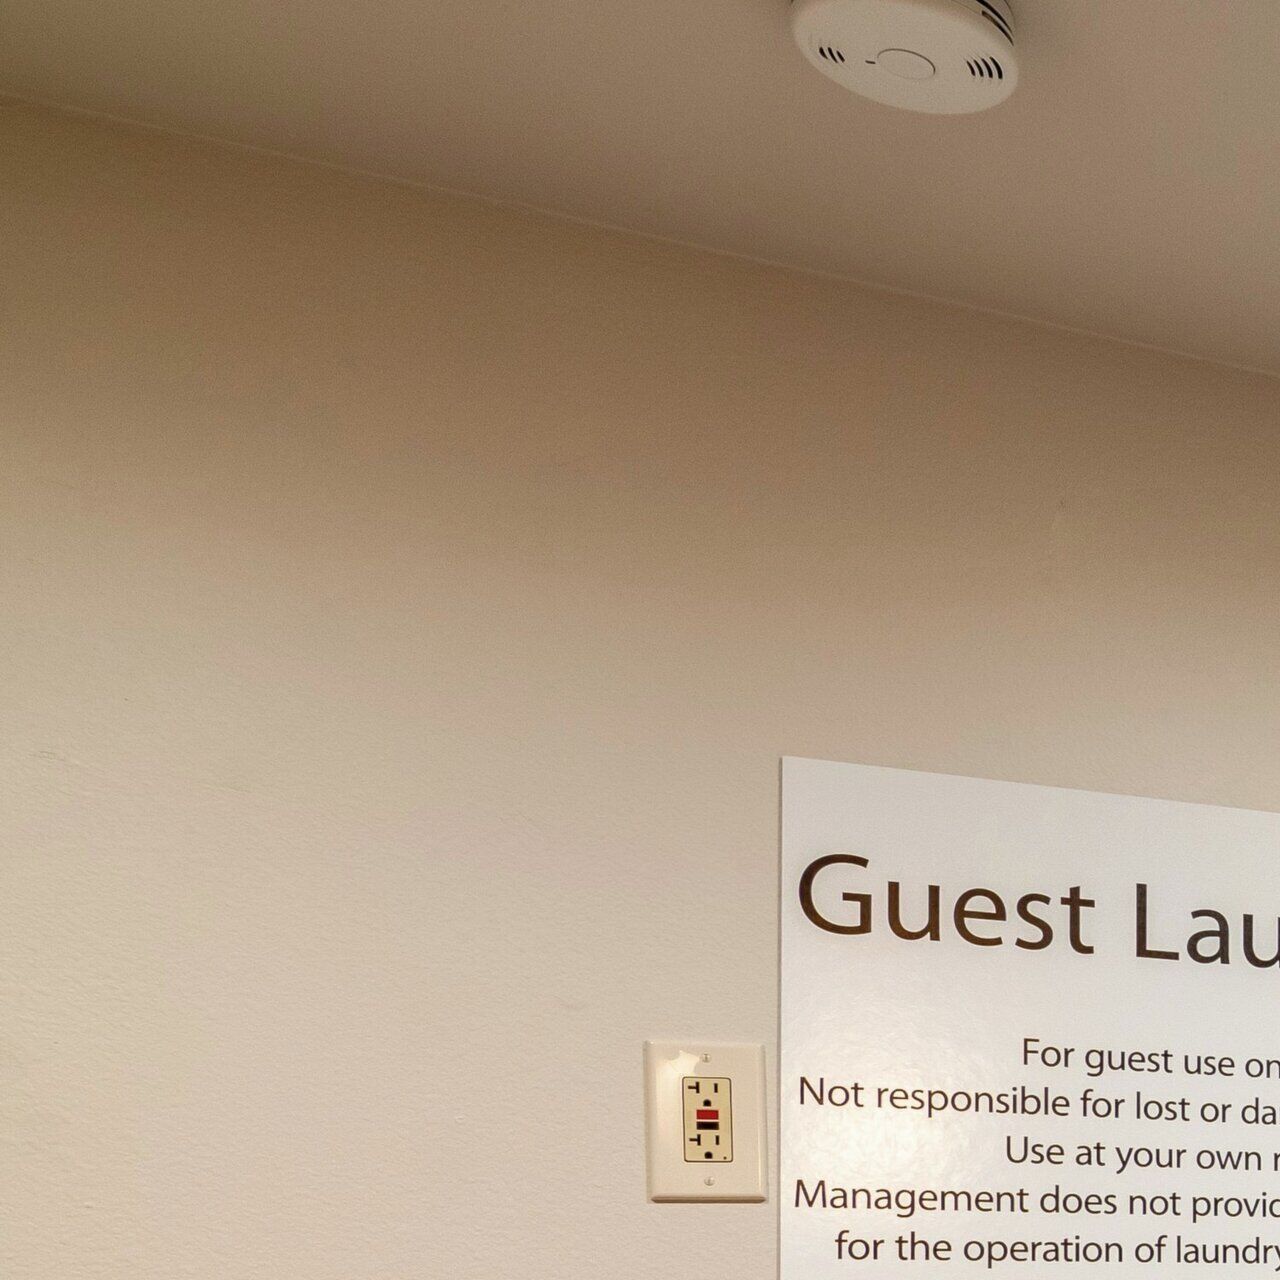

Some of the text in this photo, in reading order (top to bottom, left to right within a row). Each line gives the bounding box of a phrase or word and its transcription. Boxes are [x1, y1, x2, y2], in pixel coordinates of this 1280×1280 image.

[798, 853, 1095, 954] Guest
[1023, 1037, 1075, 1067] For
[1084, 1048, 1173, 1077] guest
[1183, 1054, 1235, 1076] use
[799, 1076, 864, 1107] Not
[877, 1085, 1070, 1118] responsible
[1079, 1088, 1125, 1118] for
[1136, 1090, 1190, 1121] lost
[1199, 1102, 1232, 1123] or
[1006, 1135, 1064, 1165] Use
[1075, 1141, 1106, 1166] at
[1114, 1146, 1187, 1174] your
[1195, 1149, 1261, 1170] own
[794, 1179, 1029, 1218] Management
[1039, 1184, 1117, 1214] does
[1129, 1191, 1181, 1216] not
[834, 1229, 884, 1260] for
[894, 1230, 952, 1261] the
[963, 1234, 1123, 1269] operation
[1134, 1234, 1168, 1263] of
